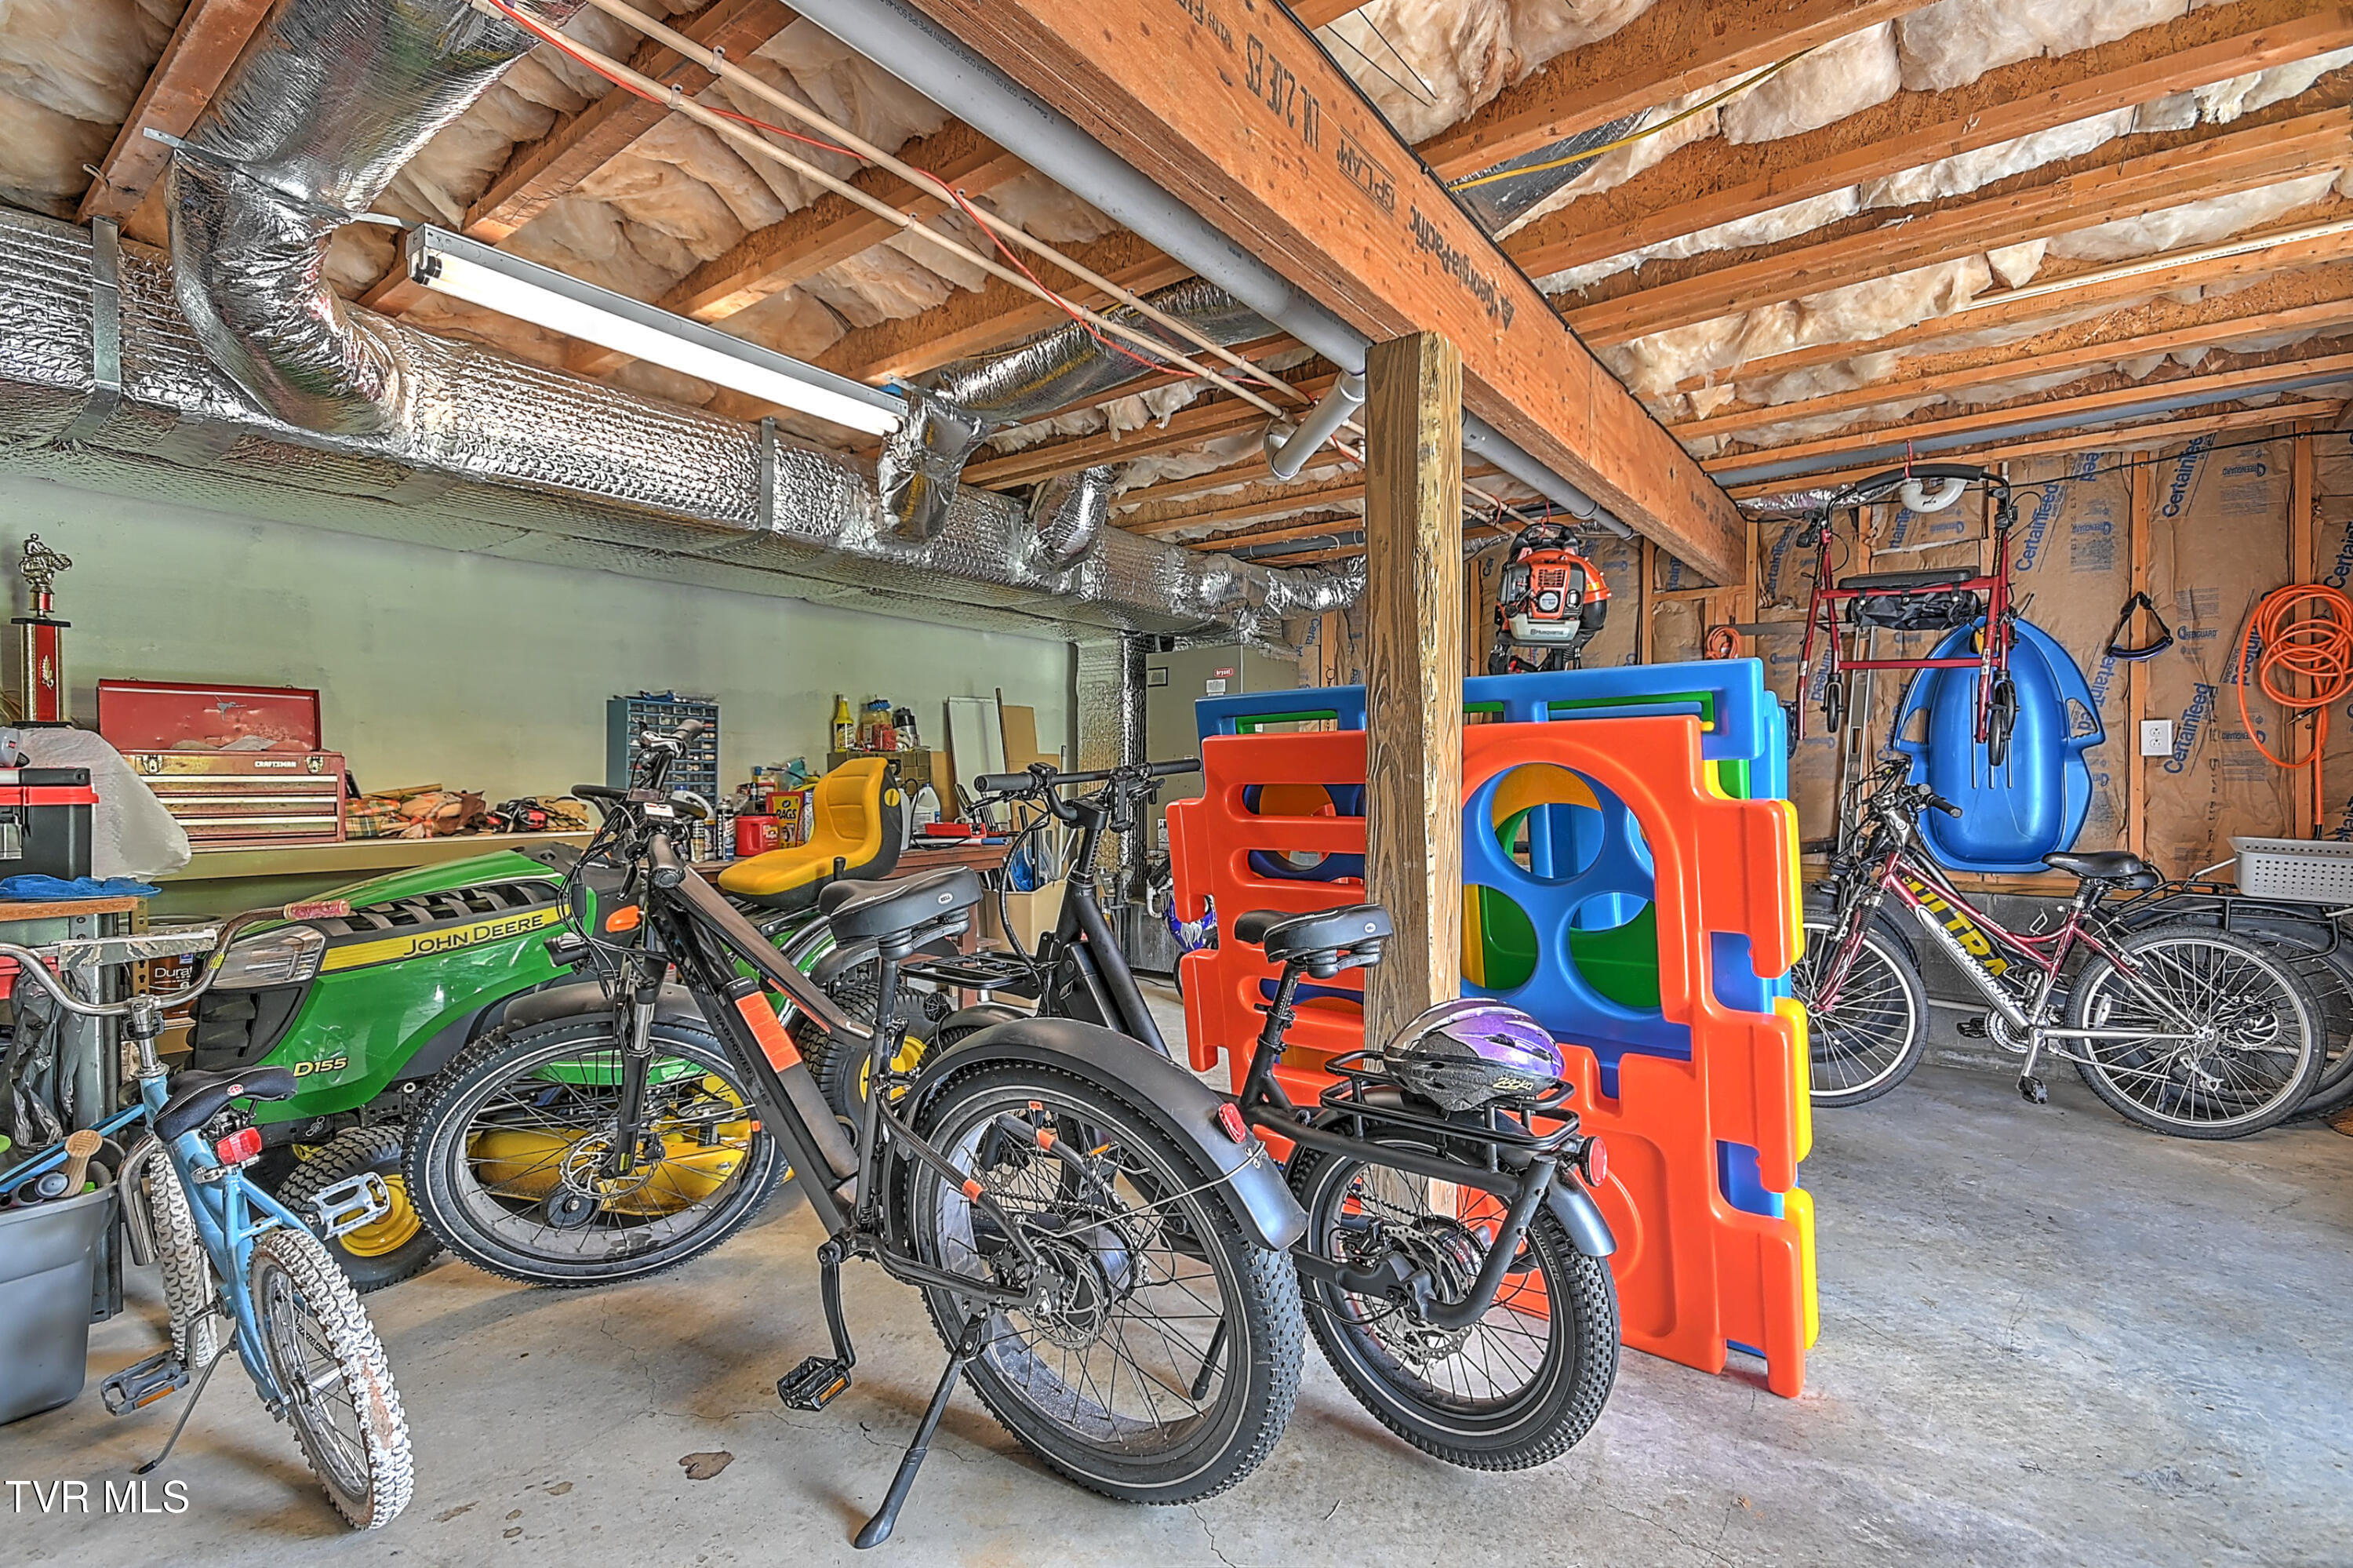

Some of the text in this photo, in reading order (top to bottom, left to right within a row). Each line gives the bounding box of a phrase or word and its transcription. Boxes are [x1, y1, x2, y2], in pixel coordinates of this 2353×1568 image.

[1208, 11, 1232, 49] WITH
[1409, 206, 1495, 317] Georgia-Pacific
[2015, 484, 2060, 572] CertainTeed
[2163, 682, 2210, 774] CertainTeed
[776, 809, 797, 820] RAGS
[403, 914, 544, 957] JOHN DEERE
[1937, 924, 2017, 1009] SCHWINN
[293, 1056, 348, 1079] D155
[715, 1013, 730, 1036] RAD
[729, 1036, 755, 1075] POWER
